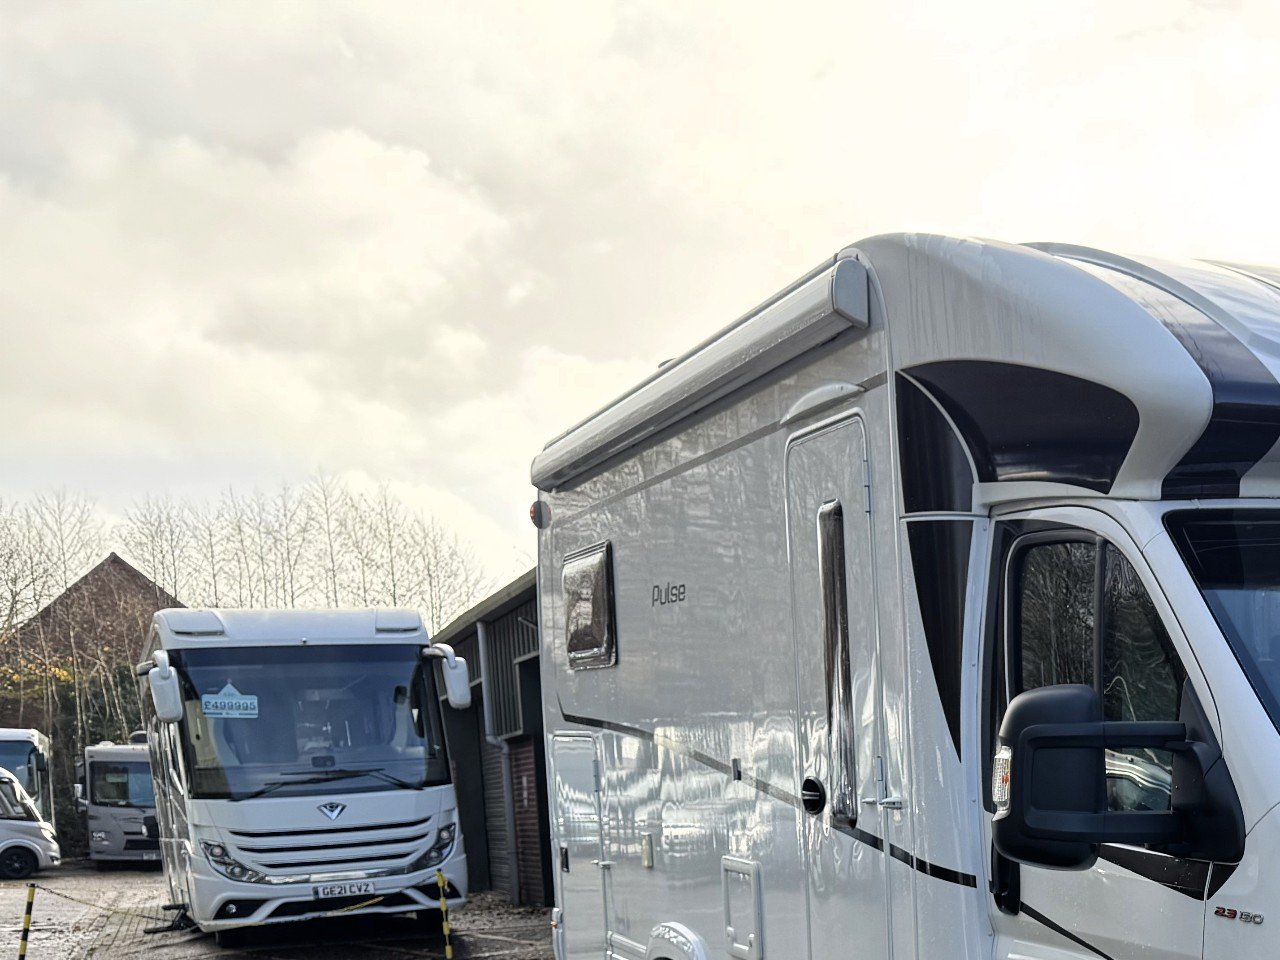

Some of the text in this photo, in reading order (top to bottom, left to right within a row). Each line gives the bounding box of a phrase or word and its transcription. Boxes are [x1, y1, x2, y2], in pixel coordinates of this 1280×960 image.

[652, 582, 686, 607] Pulse
[322, 882, 371, 897] GE21 CVZ
